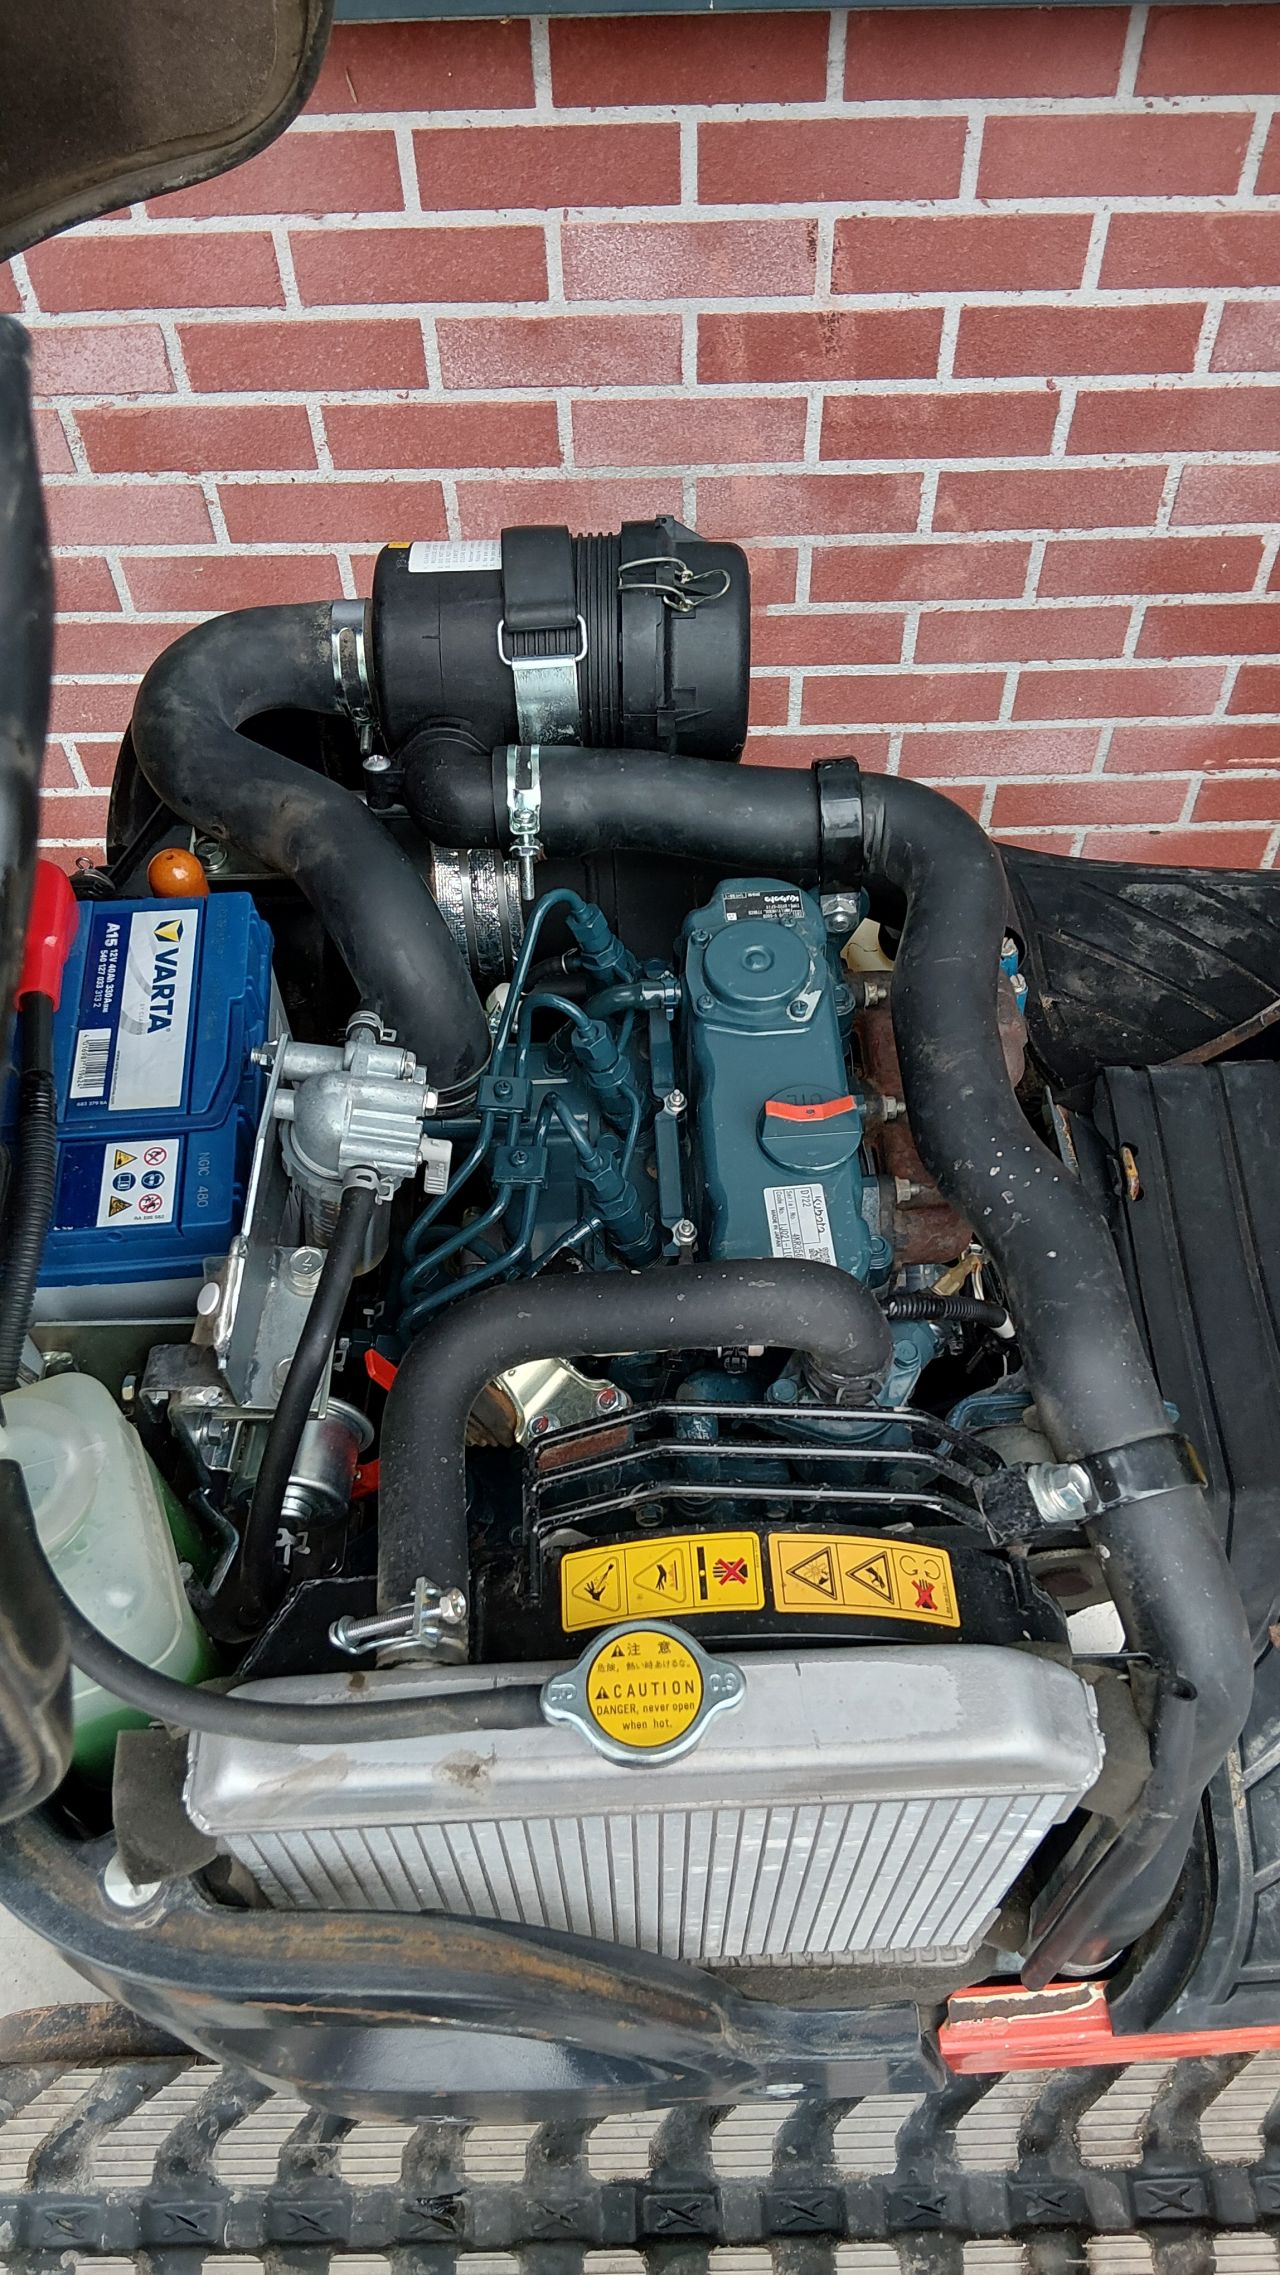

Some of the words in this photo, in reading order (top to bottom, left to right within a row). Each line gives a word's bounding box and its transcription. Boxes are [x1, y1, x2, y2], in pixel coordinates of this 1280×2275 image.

[104, 922, 120, 947] A15
[99, 950, 109, 962] 540
[109, 949, 119, 962] 12V
[97, 964, 107, 975] 127
[106, 964, 117, 983] 40Ah
[96, 977, 105, 989] 033
[147, 948, 179, 1033] VARTA
[196, 1185, 209, 1208] 480
[800, 1189, 812, 1208] D722
[813, 1195, 826, 1234] Kubota
[613, 1680, 695, 1698] CAUTION
[596, 1703, 640, 1716] DANGER,
[643, 1703, 670, 1713] never
[672, 1701, 695, 1712] open
[622, 1719, 648, 1730] when
[653, 1718, 673, 1729] hot.
